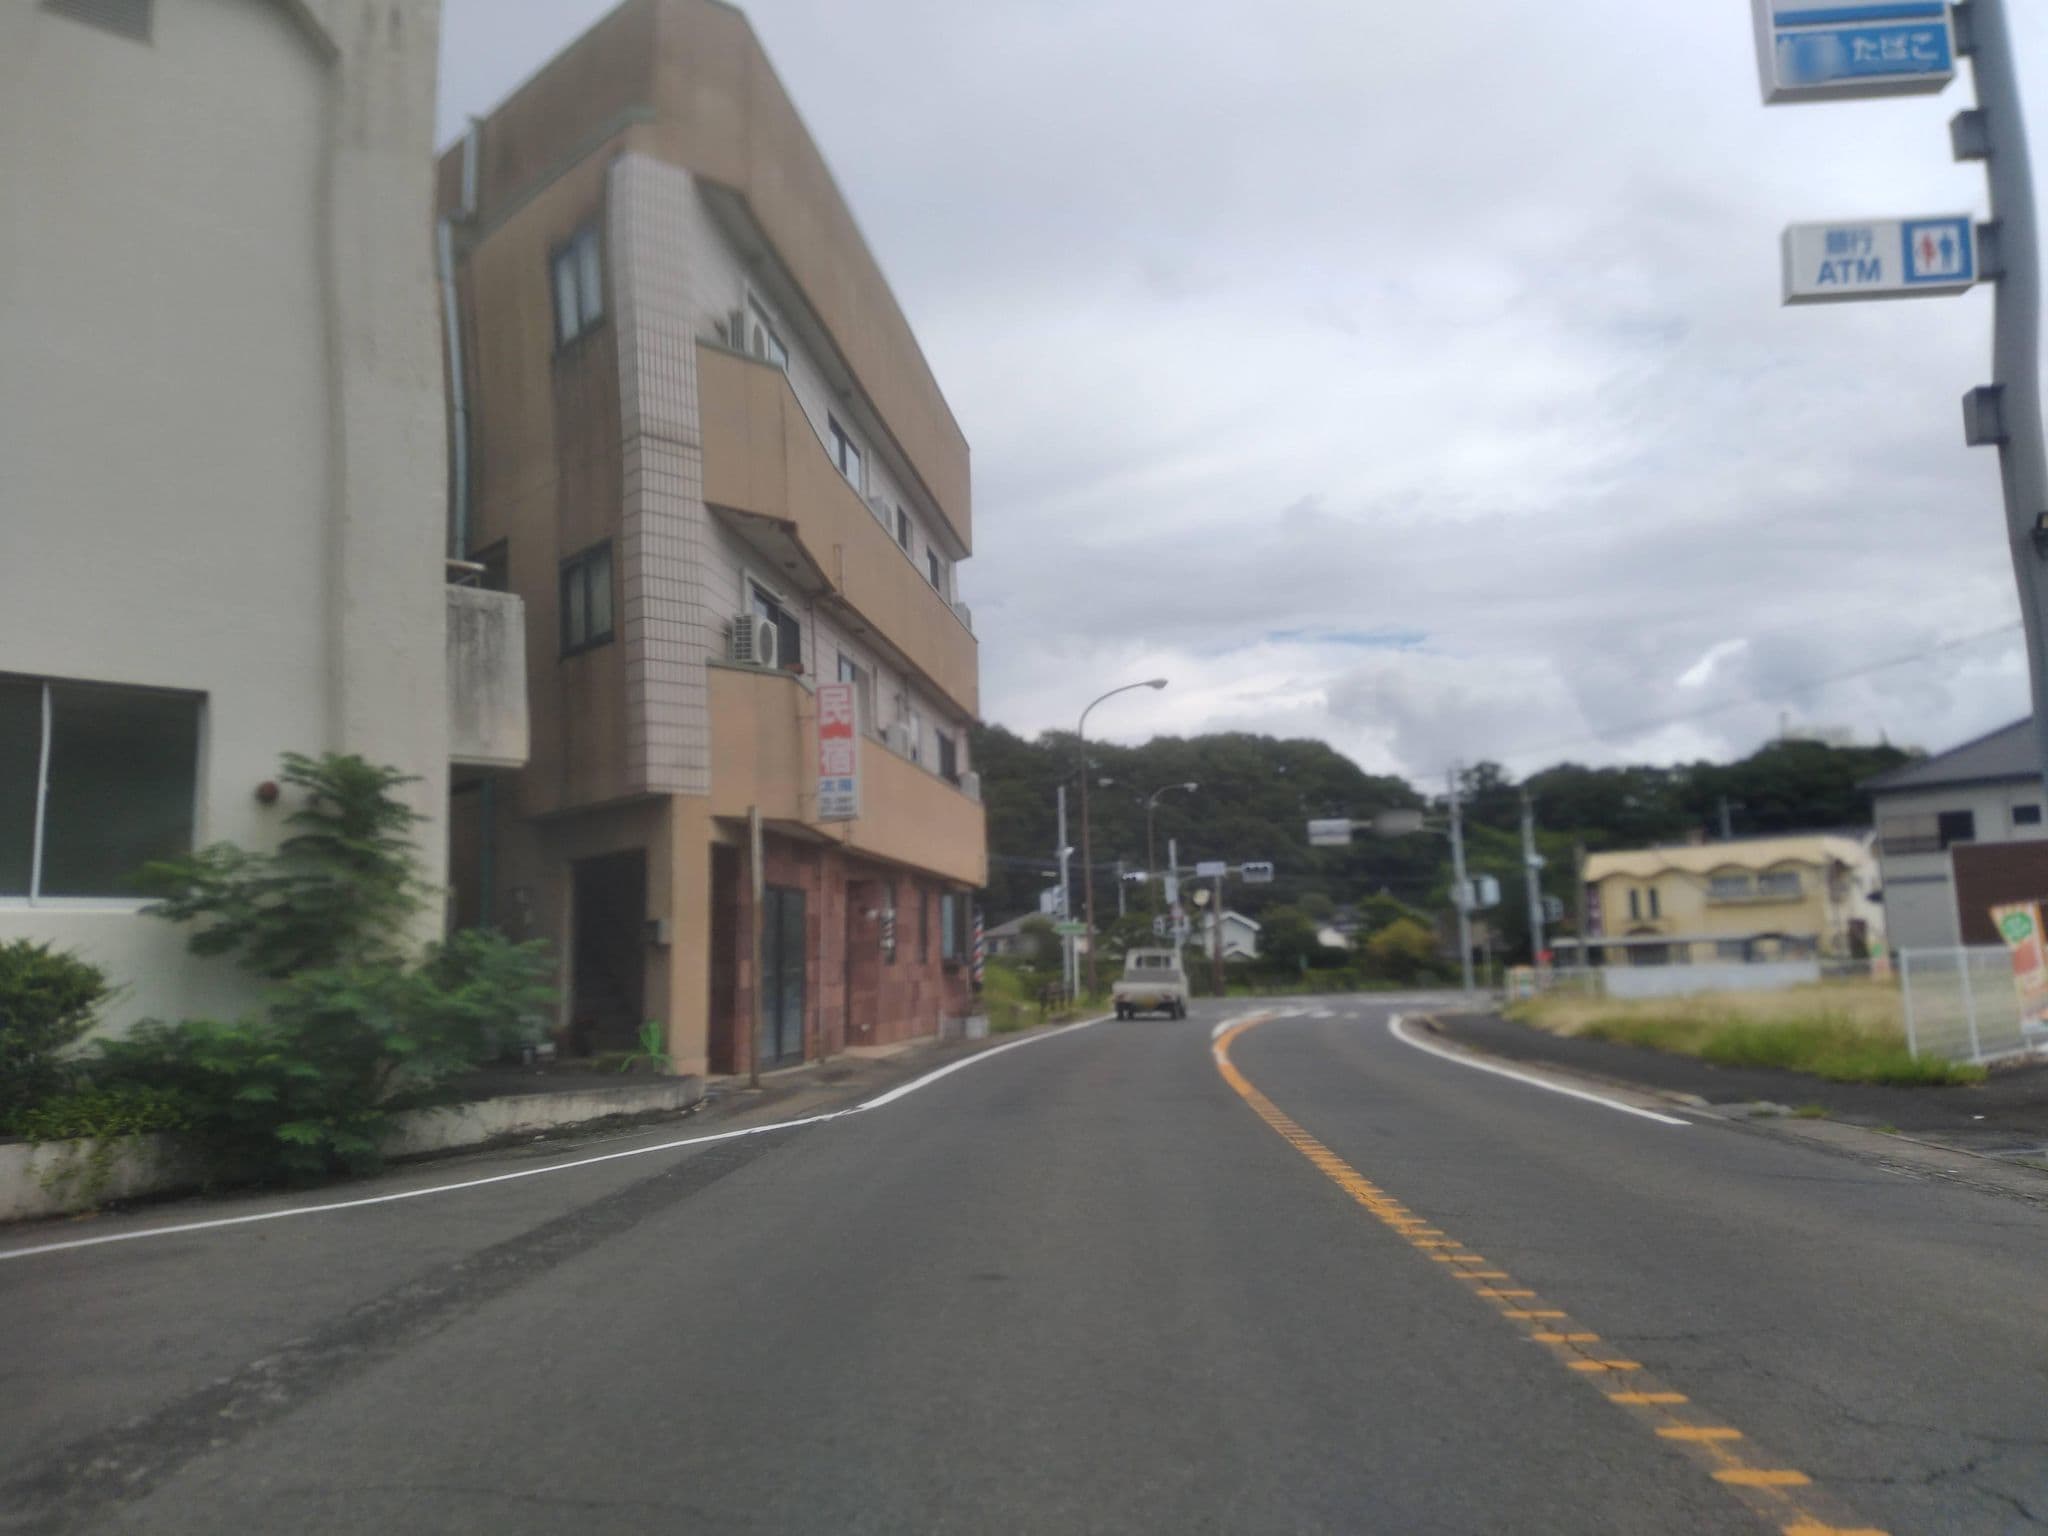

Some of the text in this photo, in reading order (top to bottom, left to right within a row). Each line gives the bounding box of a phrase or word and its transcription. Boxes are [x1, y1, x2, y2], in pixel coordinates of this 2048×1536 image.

[1852, 32, 1938, 61] たばこ
[1817, 258, 1880, 284] ATM
[821, 687, 852, 774] 民宿
